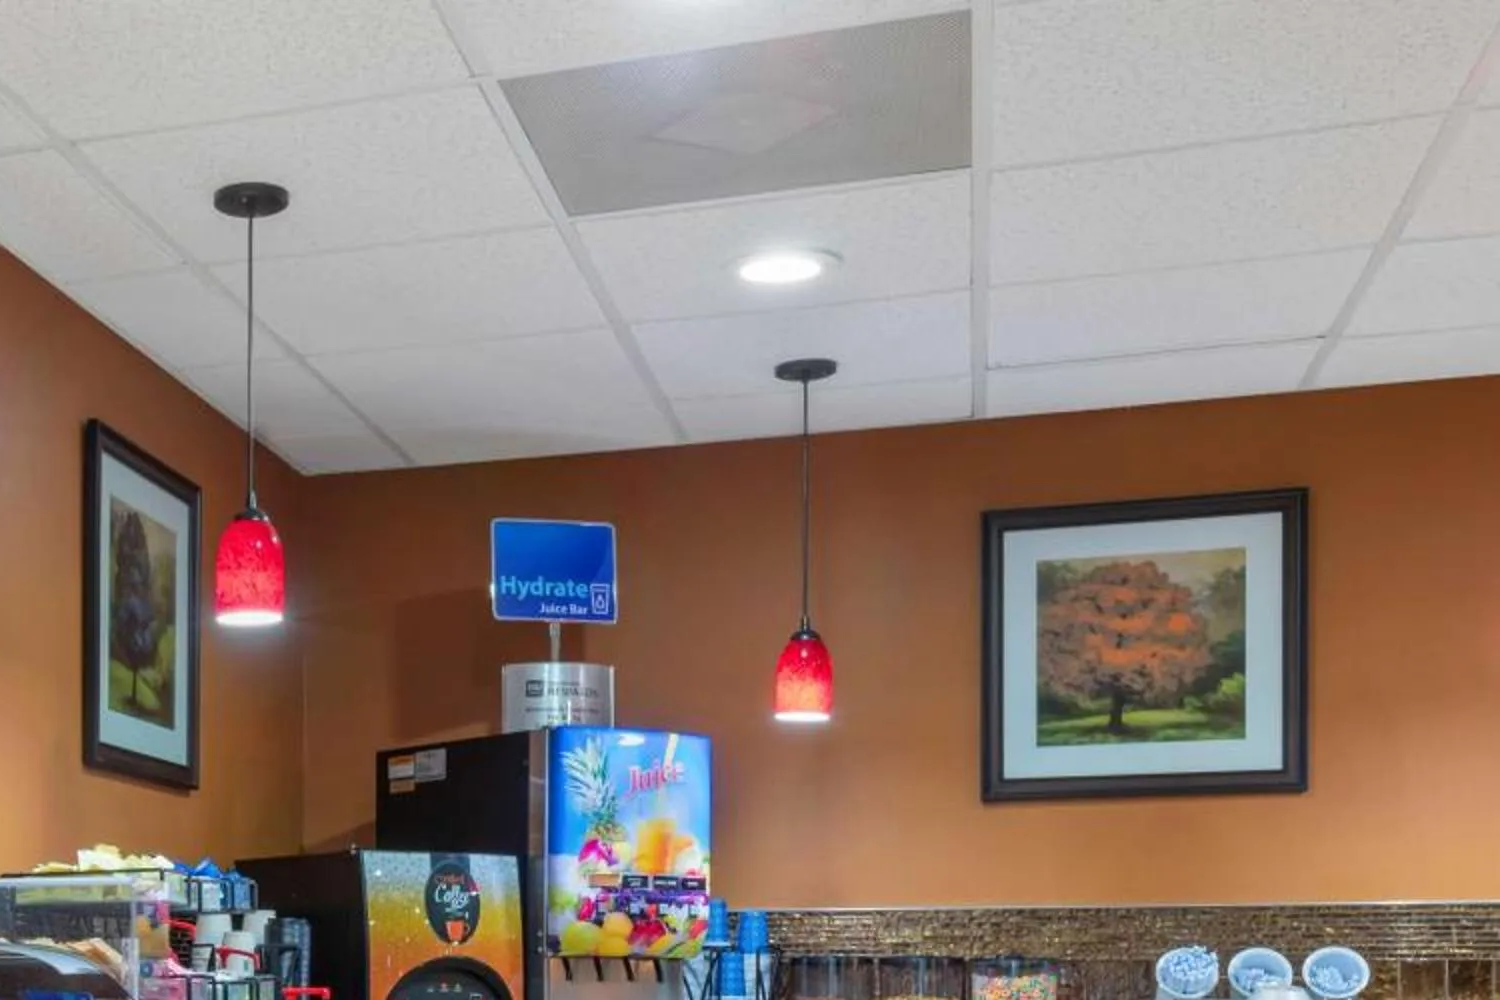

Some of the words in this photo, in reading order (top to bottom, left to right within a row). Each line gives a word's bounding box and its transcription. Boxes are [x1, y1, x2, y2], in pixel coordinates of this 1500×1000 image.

[500, 575, 589, 600] Hydrate
[539, 602, 567, 615] Juice
[569, 603, 588, 615] Bar
